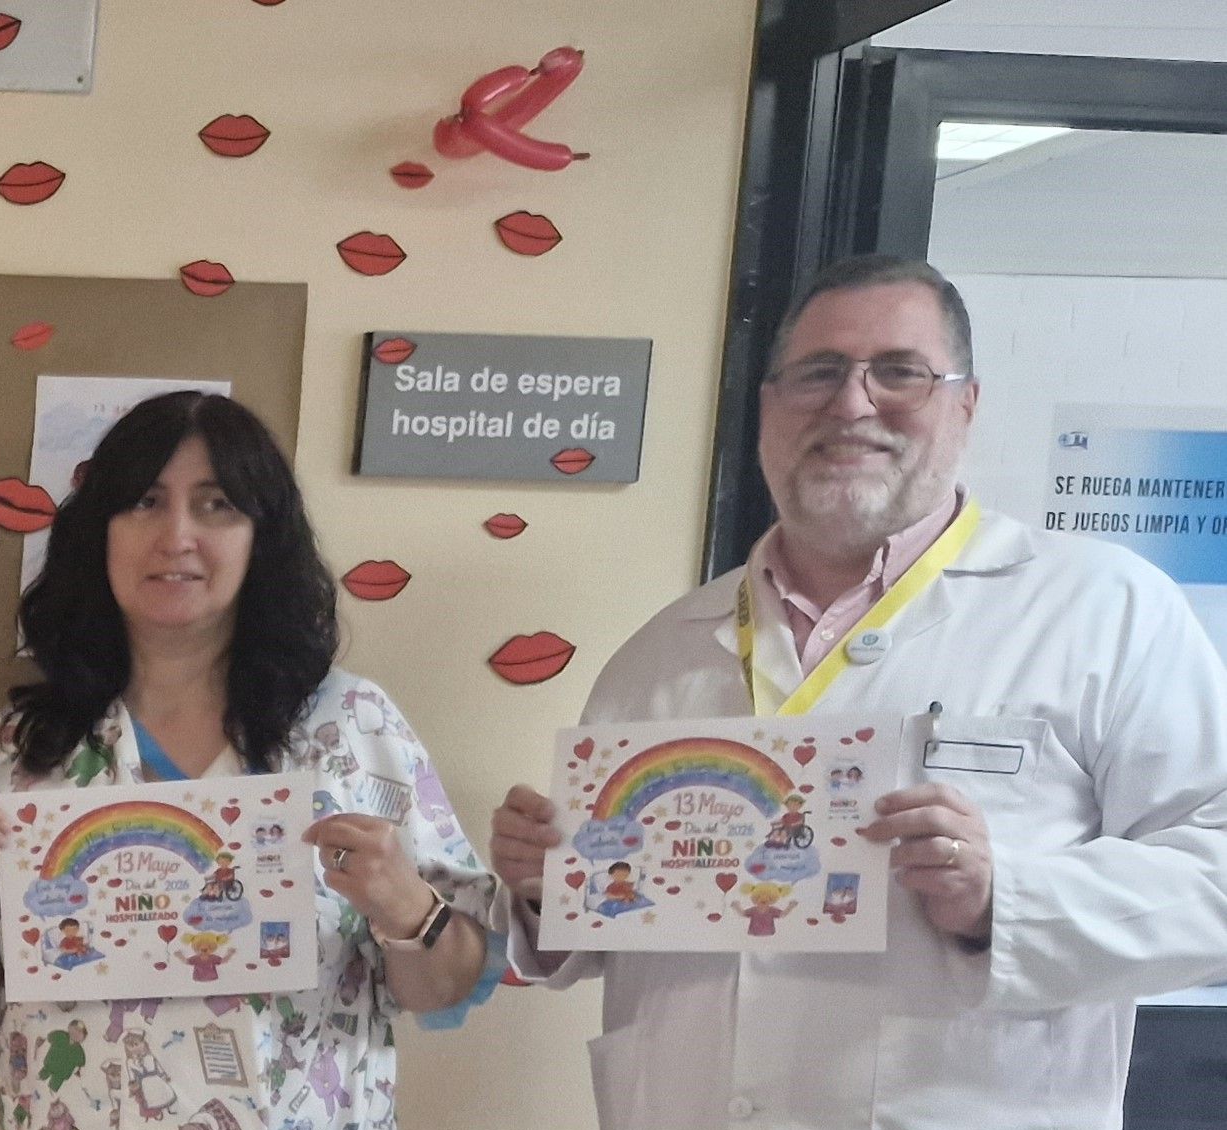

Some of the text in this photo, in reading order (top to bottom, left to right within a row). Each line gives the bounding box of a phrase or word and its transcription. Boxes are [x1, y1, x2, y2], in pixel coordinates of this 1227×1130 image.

[394, 364, 622, 401] Sala de espera
[391, 408, 616, 443] hospital de día
[1054, 475, 1226, 499] SE RUEGA MANTENER
[1045, 511, 1066, 531] DE
[1072, 512, 1130, 533] JUEGOS
[1135, 514, 1190, 535] LIMPIA
[1197, 515, 1207, 535] Y
[673, 791, 746, 824] 13 Mayo
[113, 851, 180, 881] 13 Mayo
